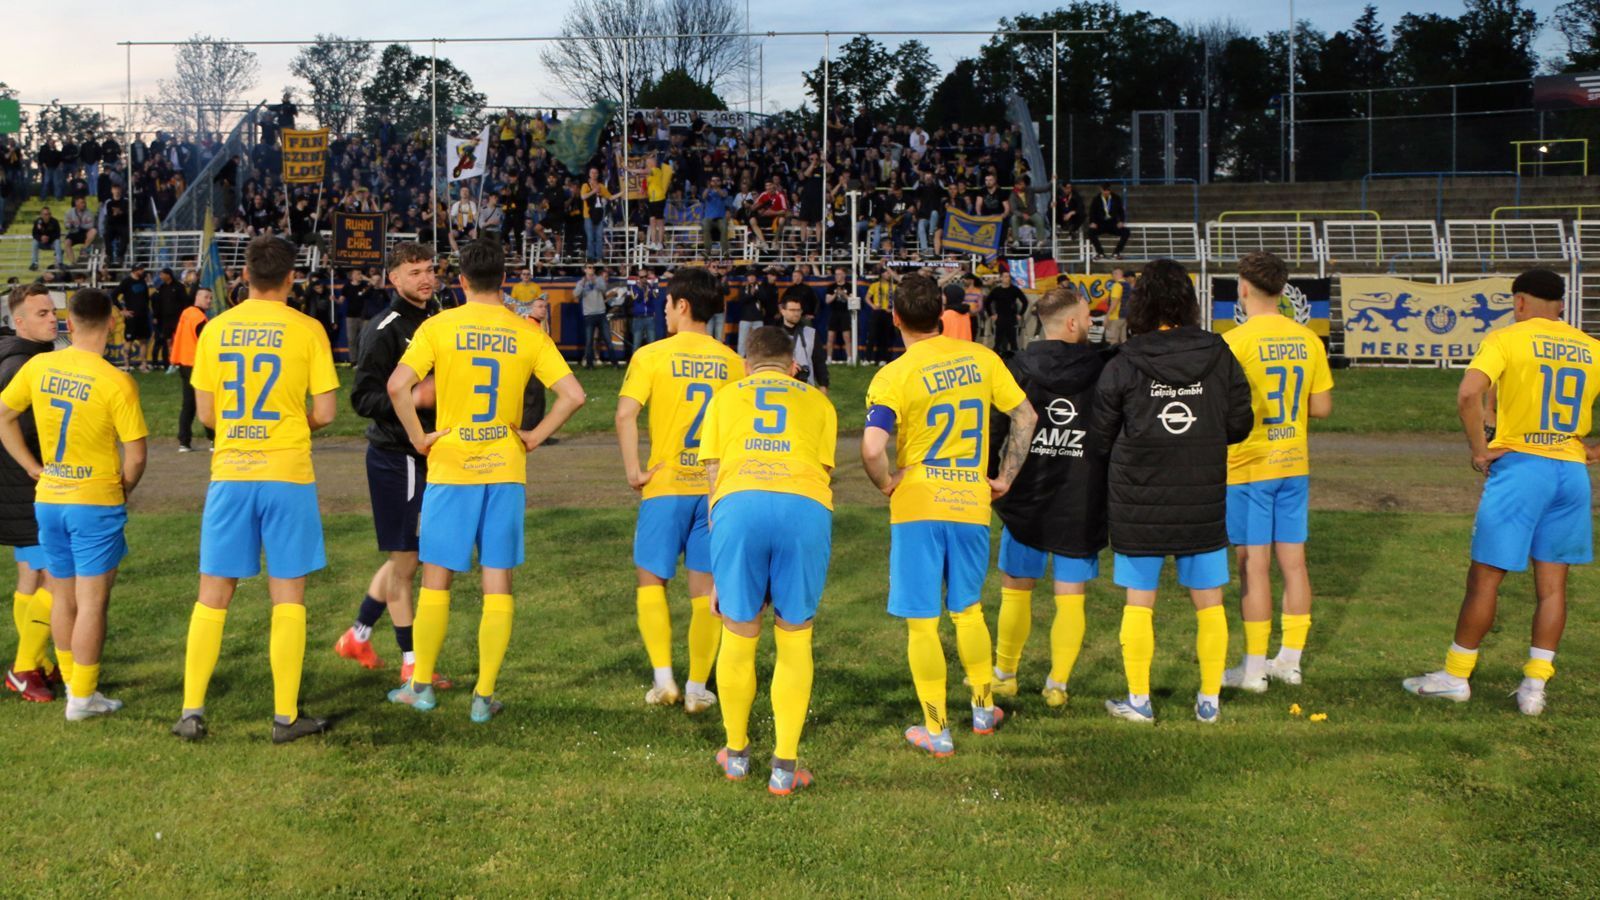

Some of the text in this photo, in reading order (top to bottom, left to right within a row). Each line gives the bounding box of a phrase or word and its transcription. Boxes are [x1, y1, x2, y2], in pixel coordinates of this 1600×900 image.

[713, 112, 745, 126] 1966
[289, 137, 323, 148] FAN
[289, 165, 321, 176] LOK
[345, 218, 374, 231] RUHM
[346, 237, 372, 249] EHRE
[220, 329, 284, 348] LEIPZIG
[456, 332, 518, 354] LEIPZIG
[1258, 344, 1308, 362] LEIPZIG
[1532, 340, 1593, 364] LEIPZIG
[671, 359, 728, 380] LEIPZIG
[922, 363, 982, 395] LEIPZIG
[40, 375, 92, 401] LEIPZIG
[218, 352, 282, 420] 32
[471, 356, 500, 423] 3
[1150, 386, 1203, 398] Leipzig GmbH
[1262, 365, 1304, 424] 31
[1539, 364, 1586, 433] 19
[683, 382, 714, 449] 2
[753, 387, 788, 434] 5
[50, 398, 73, 463] 7
[459, 425, 508, 441] EGLSEDER
[921, 398, 983, 468] 23
[1032, 428, 1087, 448] AMZ
[1267, 427, 1296, 441] GRYM
[744, 439, 791, 452] URBAN
[1030, 446, 1084, 458] Leipzig GmbH
[679, 452, 701, 467] GO
[925, 468, 980, 483] PFEFFER
